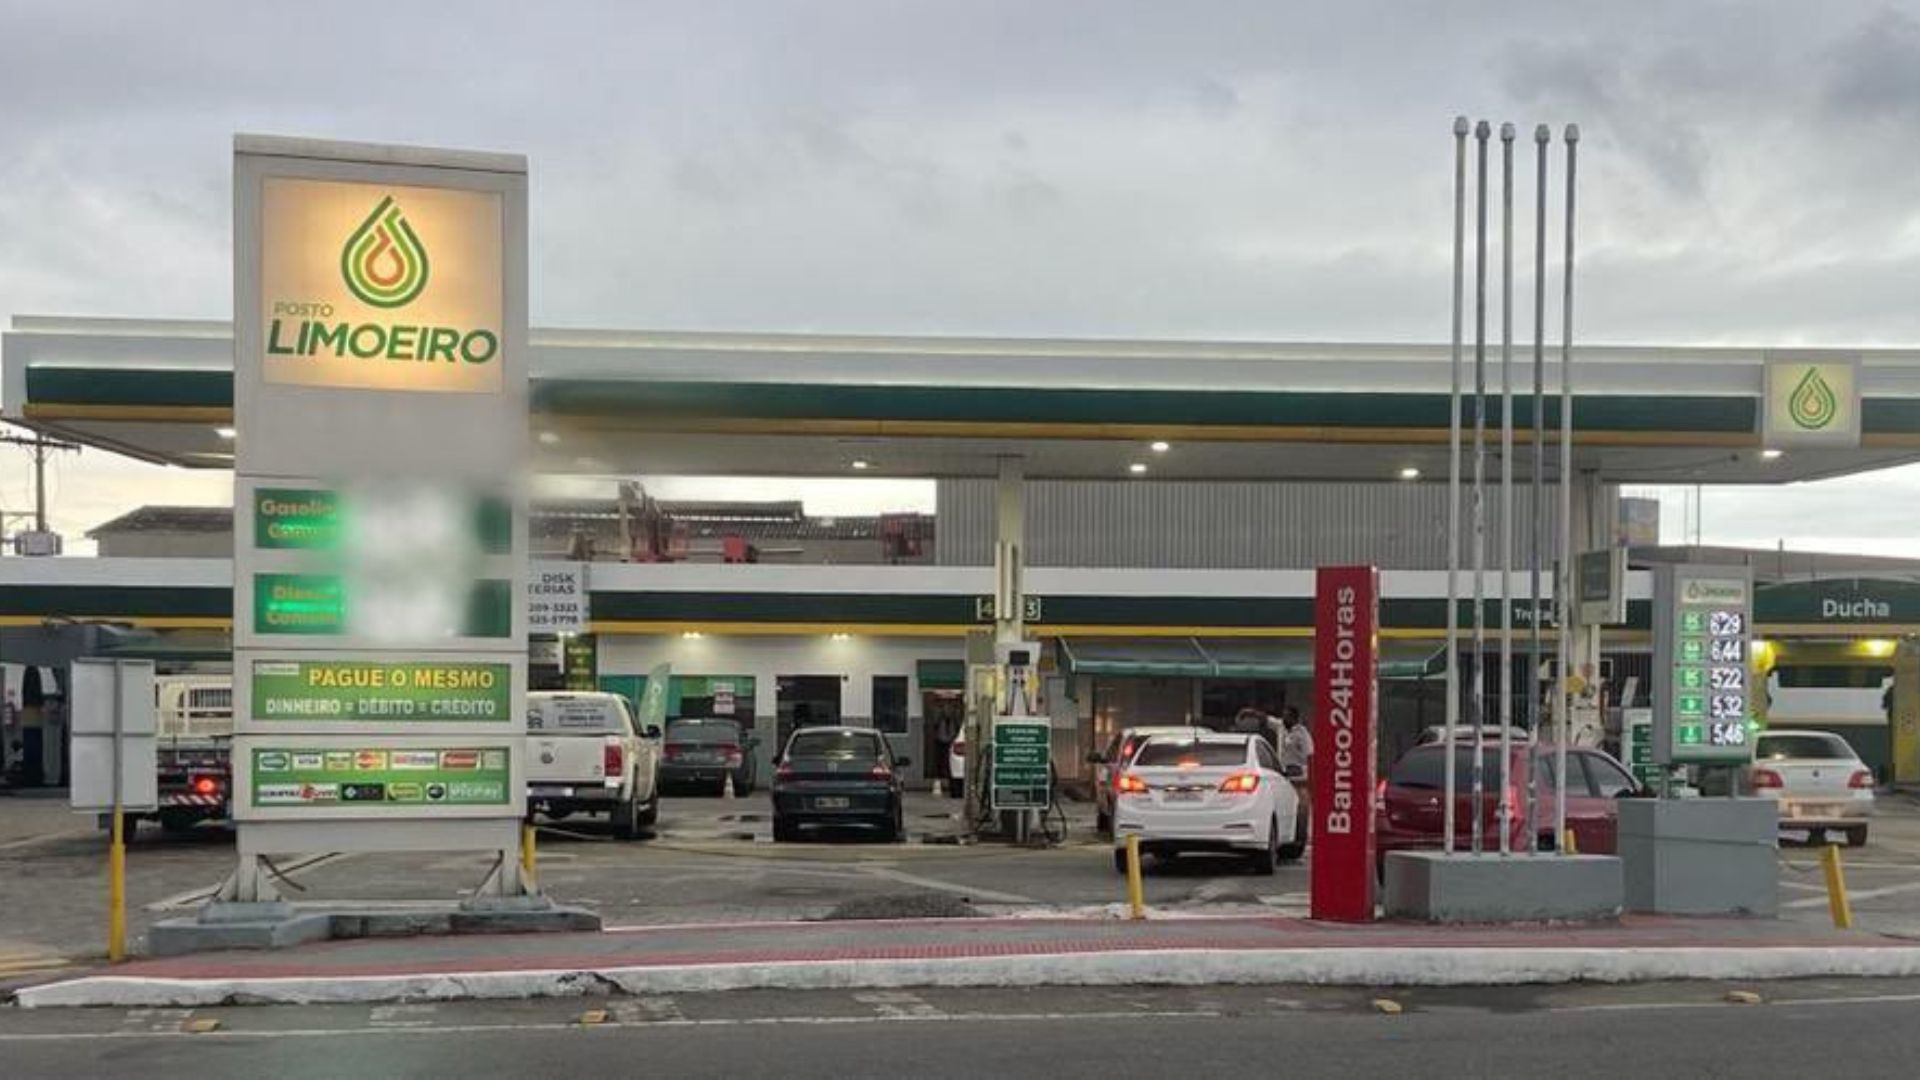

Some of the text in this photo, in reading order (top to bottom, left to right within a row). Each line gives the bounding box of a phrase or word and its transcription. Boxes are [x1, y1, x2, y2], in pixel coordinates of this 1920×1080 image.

[274, 302, 334, 317] POSTO
[267, 319, 498, 363] LIMOEIRO
[542, 573, 576, 583] DISK
[1822, 598, 1890, 617] Ducha
[308, 668, 494, 688] PAGUE O MESMO
[266, 698, 341, 715] DINHEIRO
[1327, 586, 1355, 834] Banco24Horas
[1711, 696, 1743, 719] 5,32
